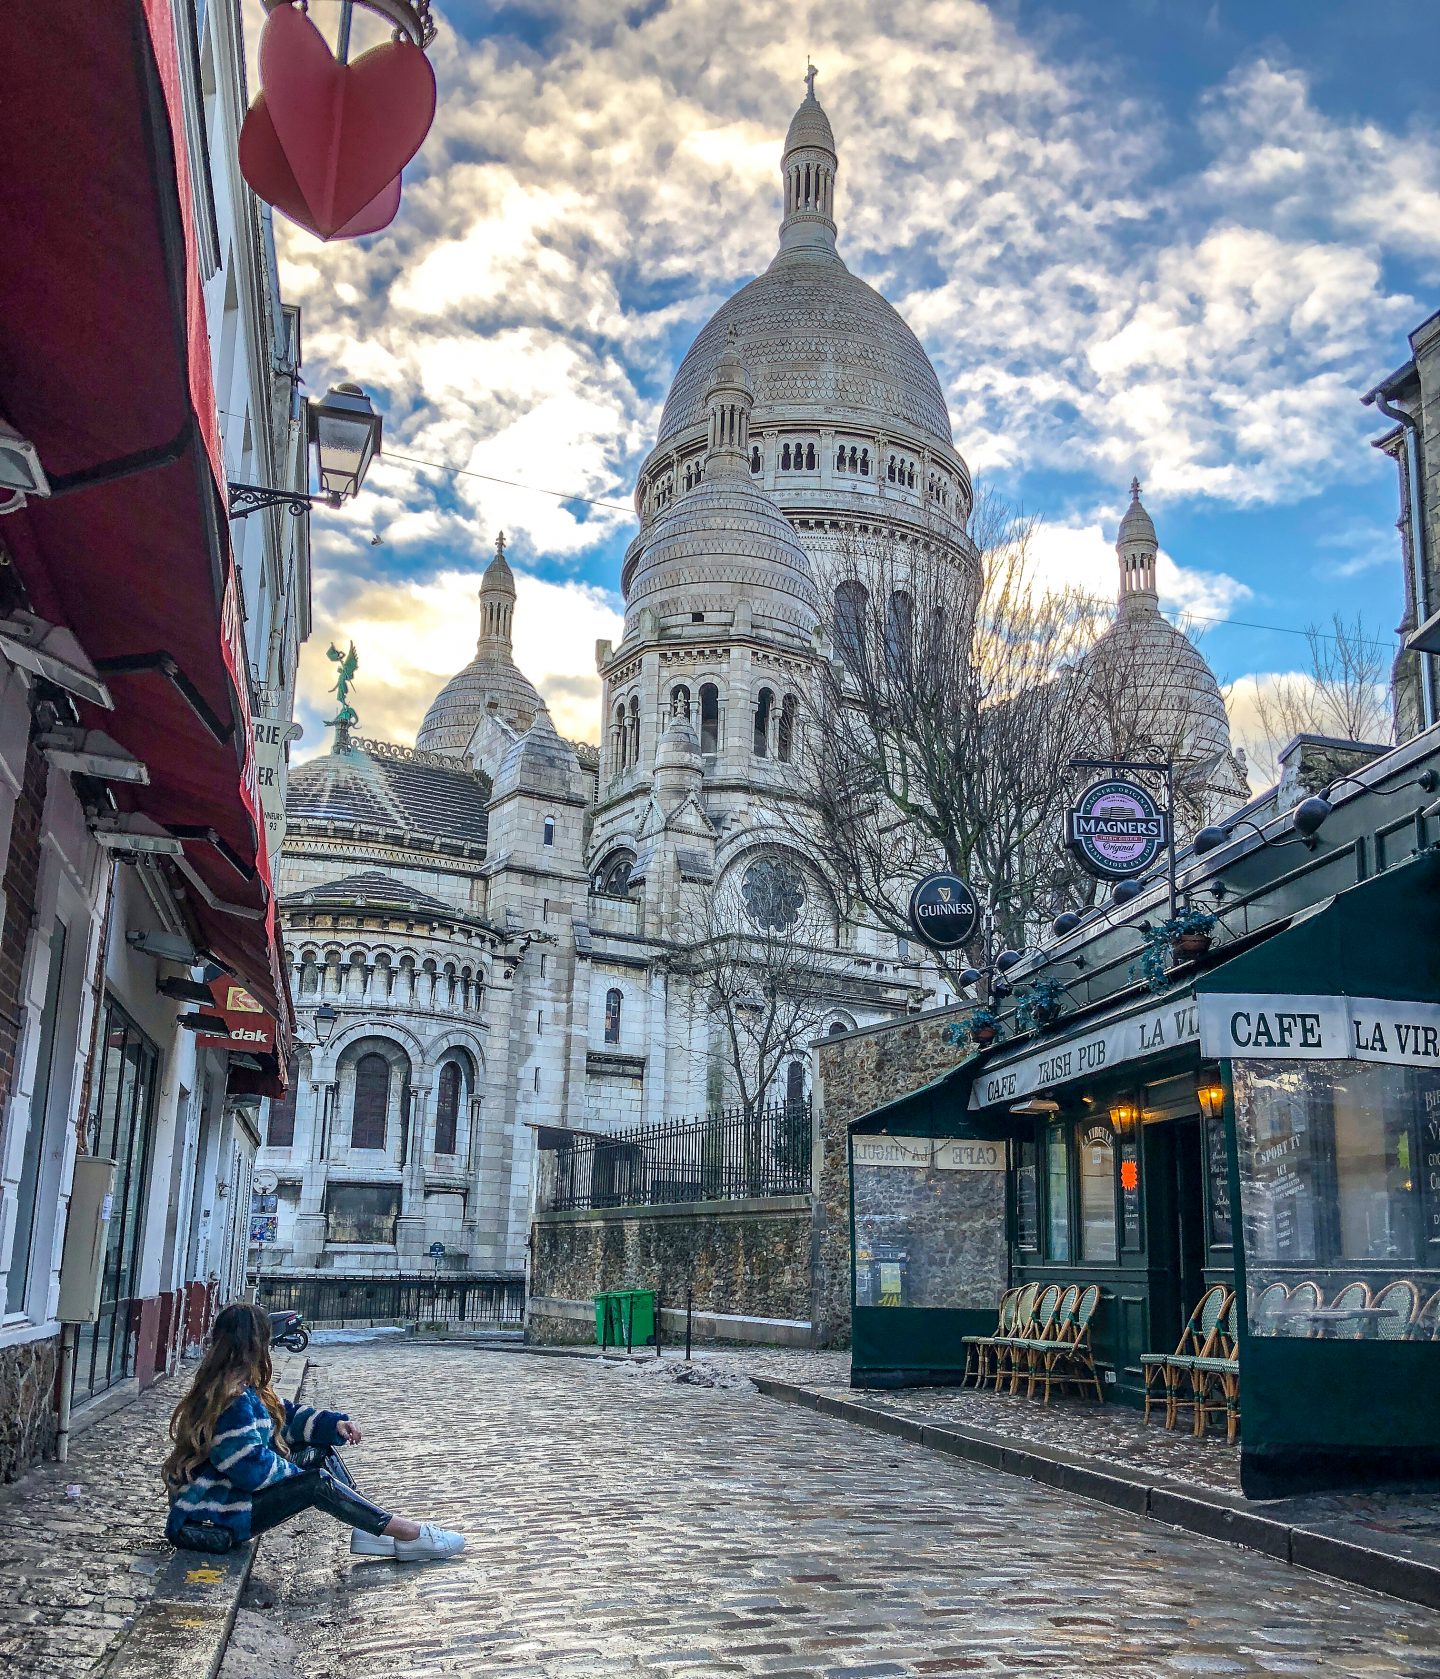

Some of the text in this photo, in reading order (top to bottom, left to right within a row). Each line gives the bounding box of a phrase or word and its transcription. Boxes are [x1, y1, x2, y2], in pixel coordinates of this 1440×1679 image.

[252, 723, 280, 745] RIE
[1085, 787, 1151, 813] MAGNERS ORIGINAL
[1080, 819, 1158, 835] MAGNERS
[1102, 842, 1135, 854] Original
[1103, 859, 1128, 868] CIDER
[919, 903, 973, 917] GUINNESS
[205, 1027, 269, 1043] dak
[1230, 1011, 1440, 1058] CAFE LA VIR
[987, 1006, 1200, 1102] CAFE IRISH PUB LA VI
[1260, 1140, 1288, 1165] SPORT
